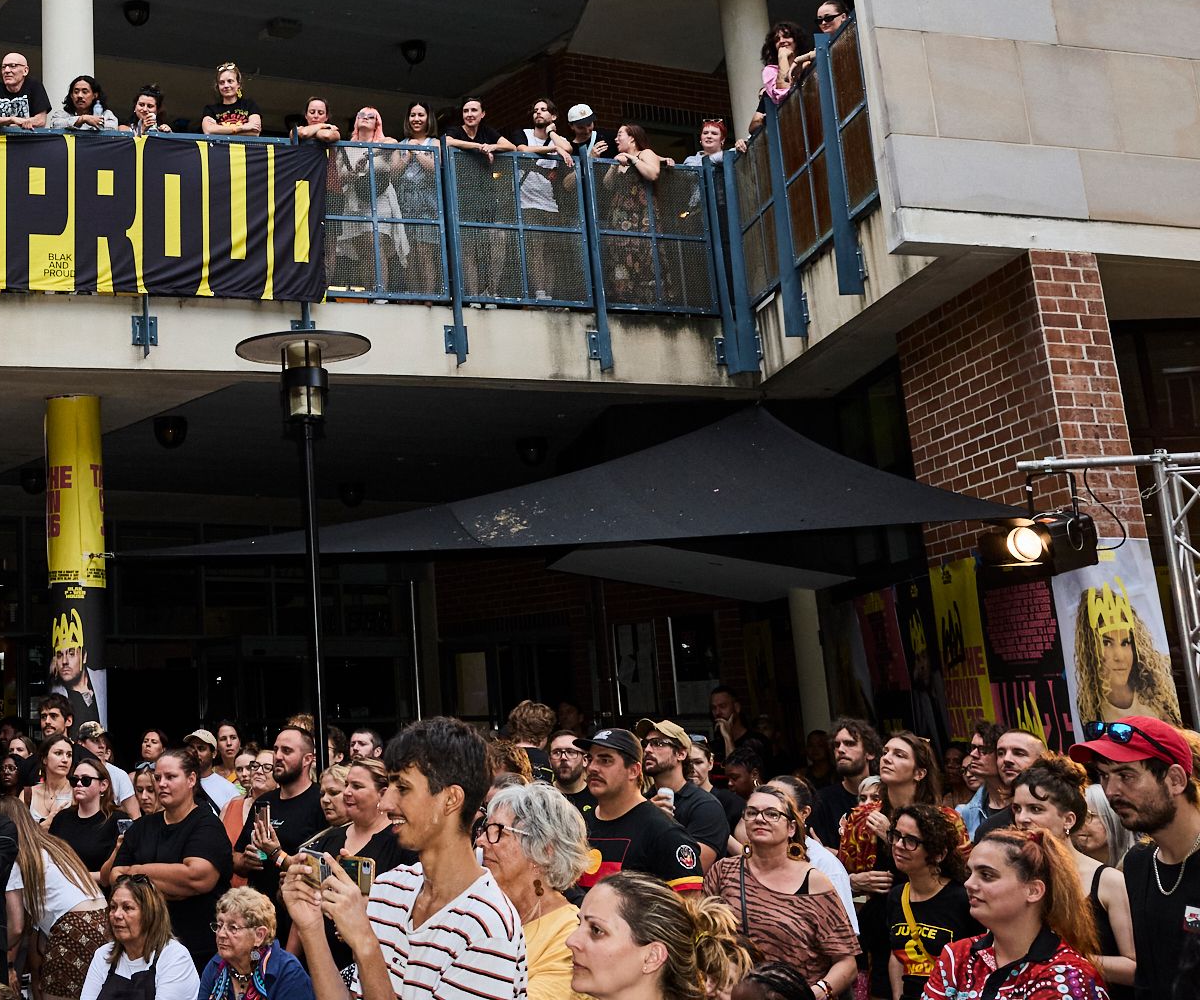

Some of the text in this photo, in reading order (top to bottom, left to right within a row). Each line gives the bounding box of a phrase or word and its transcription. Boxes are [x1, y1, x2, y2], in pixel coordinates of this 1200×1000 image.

[48, 253, 72, 261] BLAK
[49, 261, 69, 269] AND
[43, 269, 76, 278] PROUD
